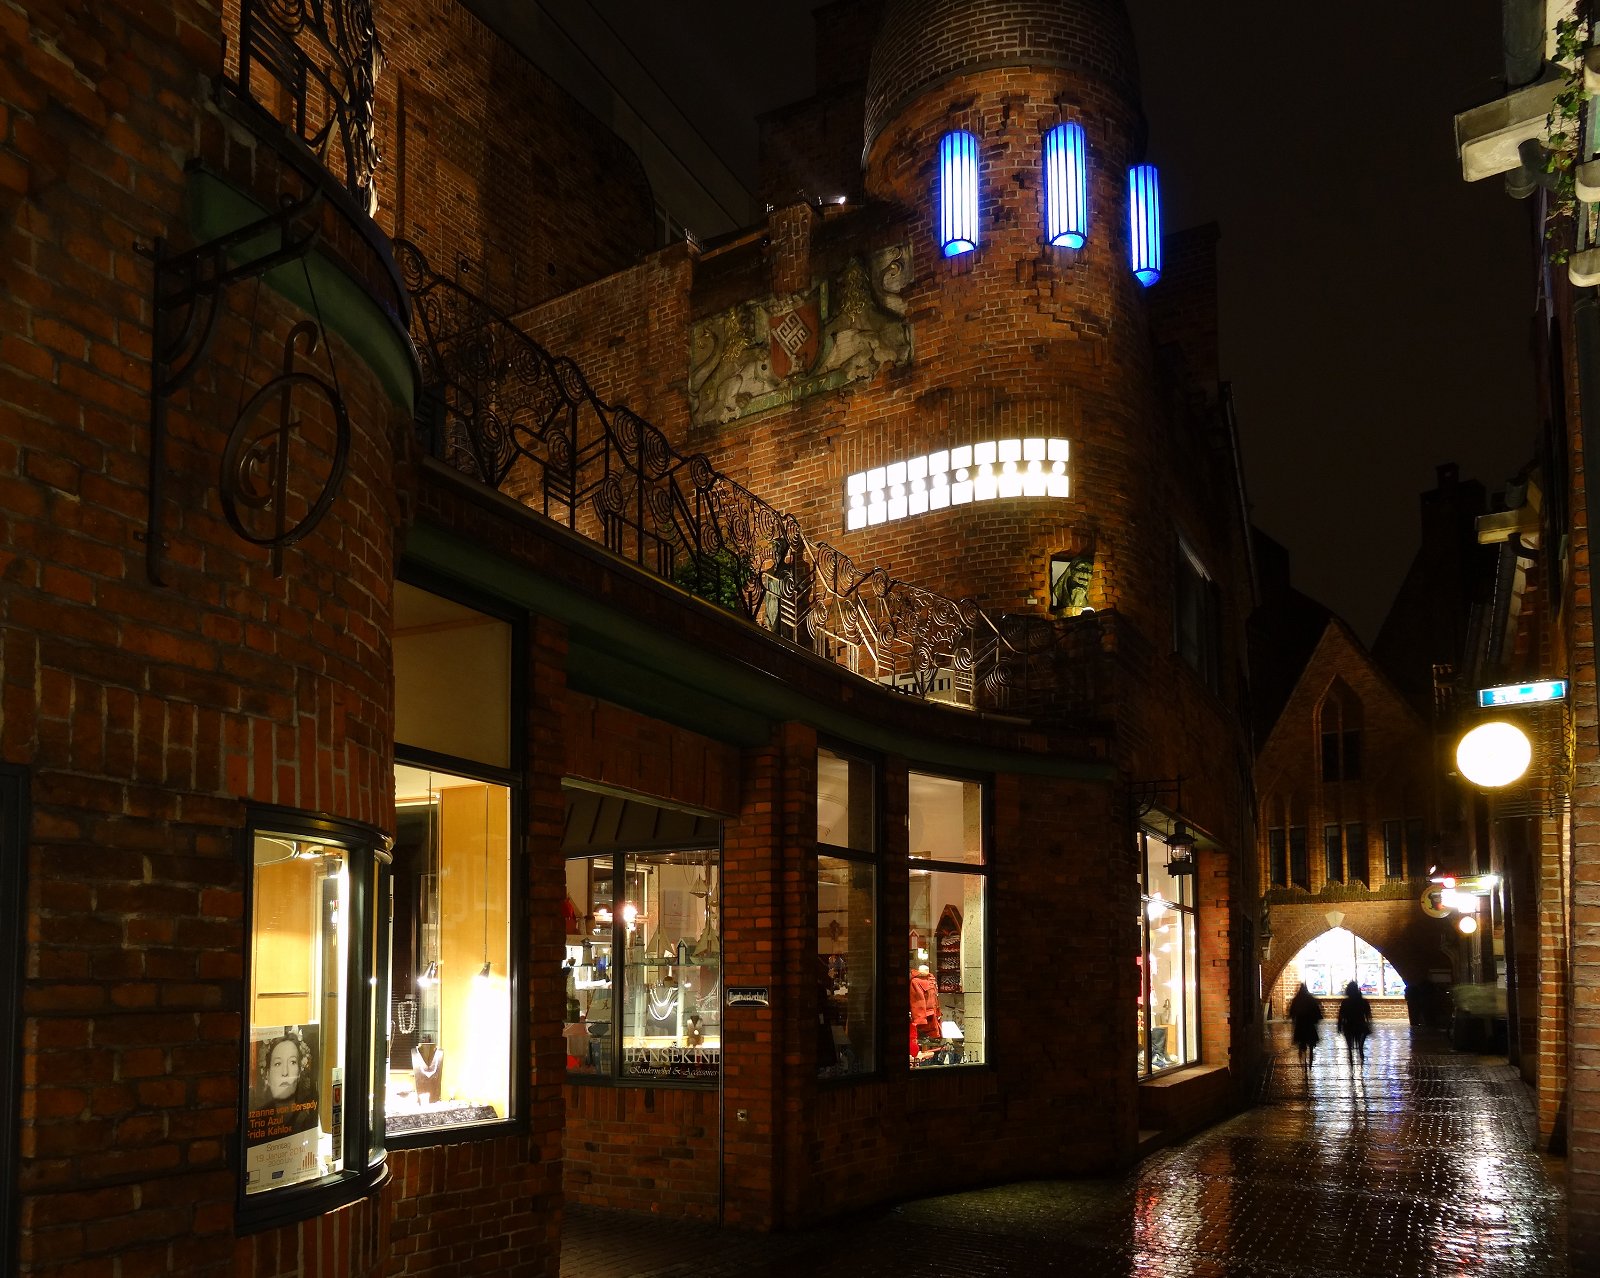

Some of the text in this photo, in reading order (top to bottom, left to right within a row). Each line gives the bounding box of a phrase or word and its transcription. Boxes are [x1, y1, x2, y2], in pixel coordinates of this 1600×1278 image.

[672, 1066, 681, 1076] &
[248, 1107, 275, 1119] uzanne
[249, 1115, 284, 1129] Trio Azul
[266, 1142, 292, 1152] Sonntag
